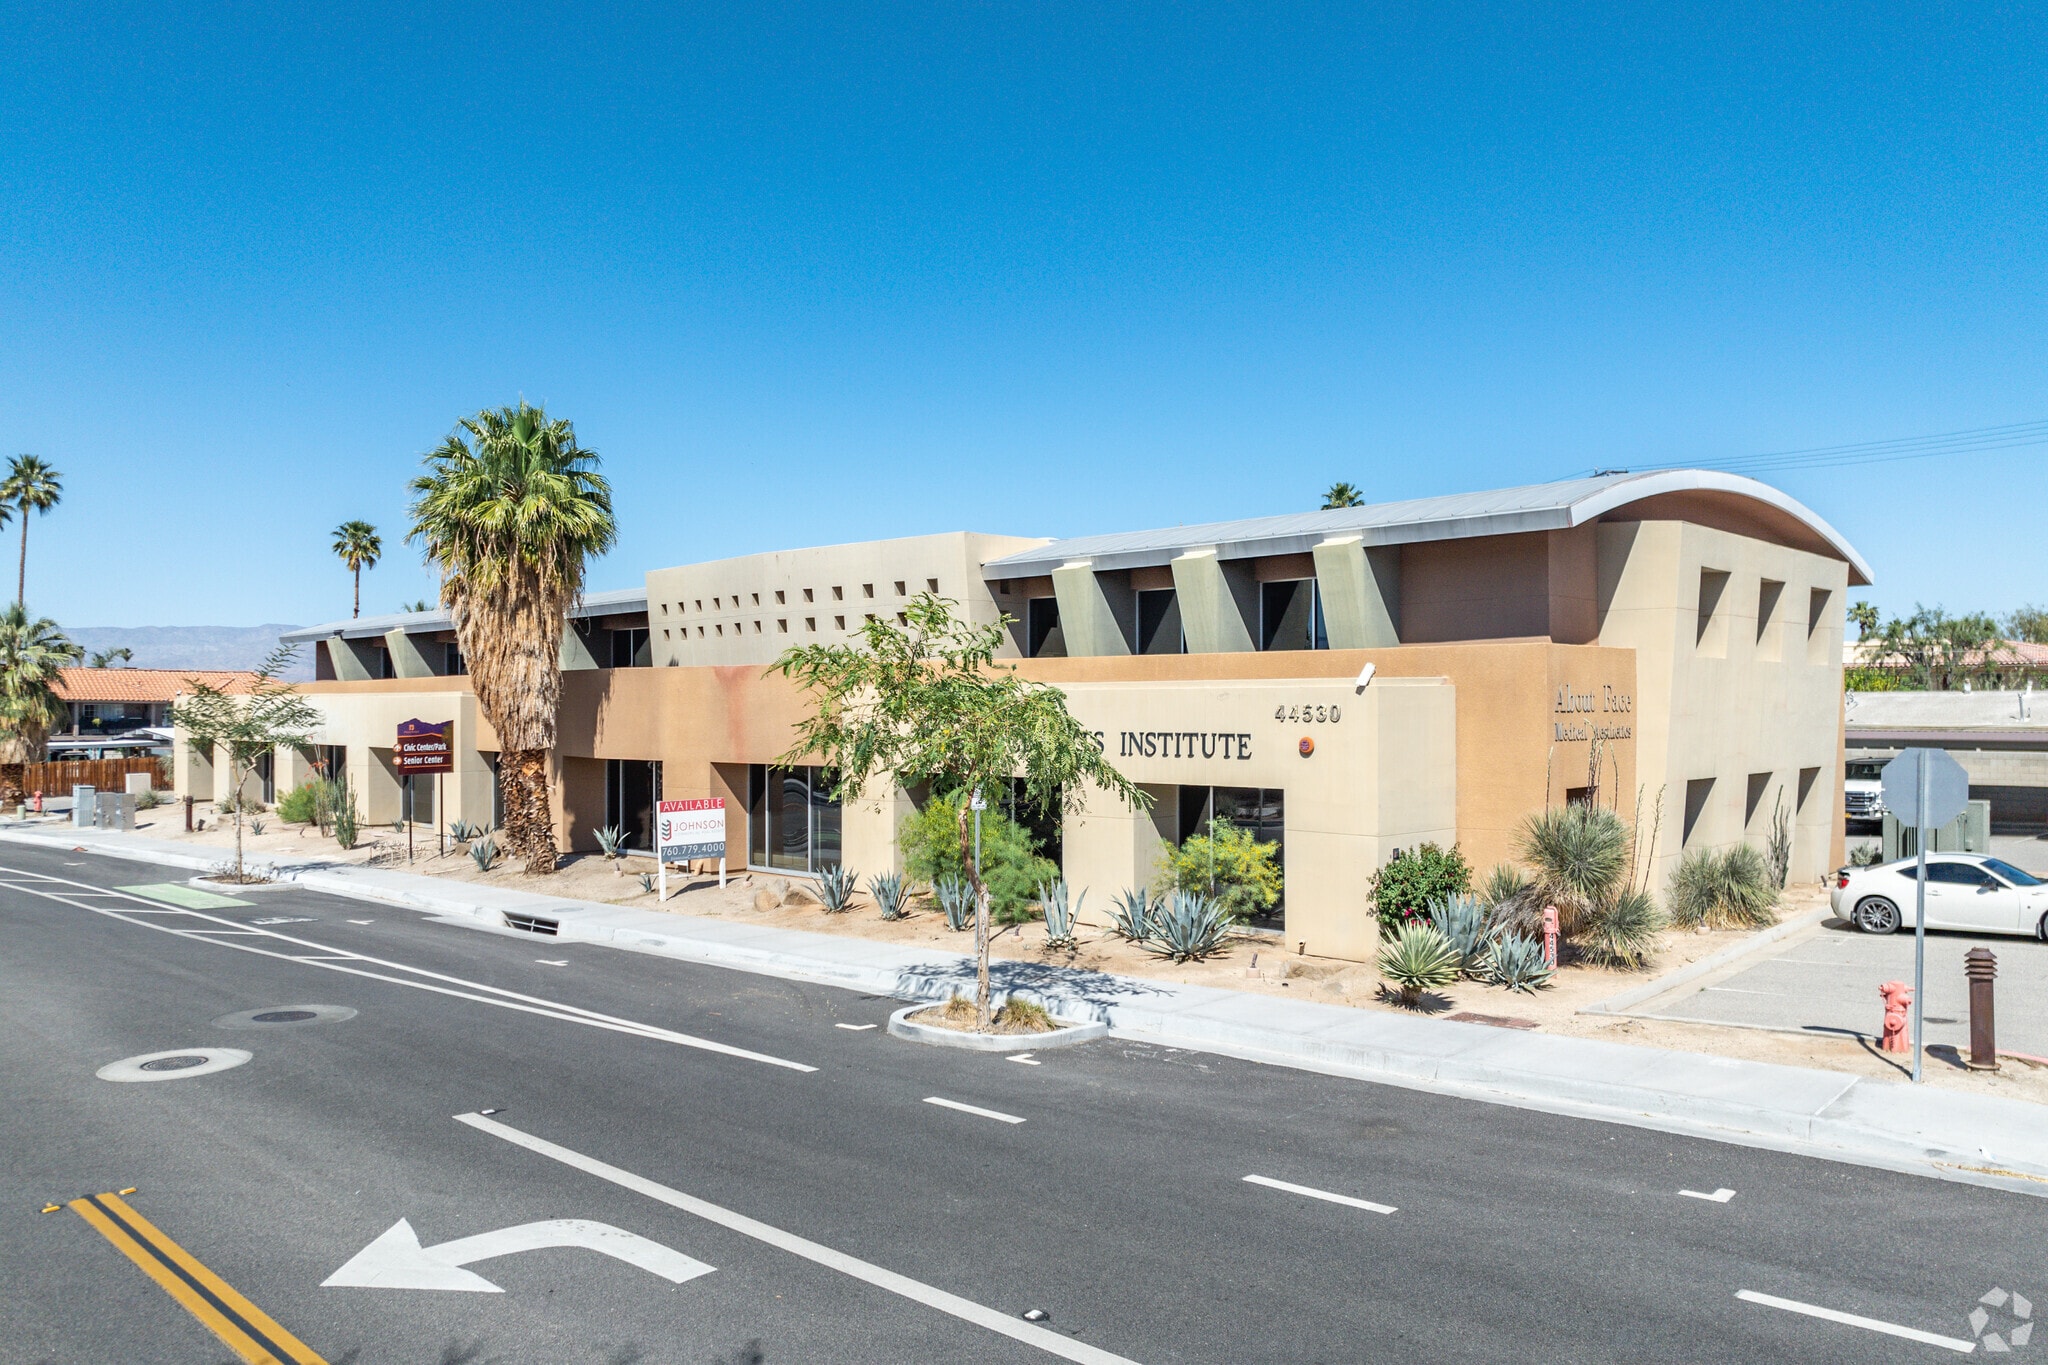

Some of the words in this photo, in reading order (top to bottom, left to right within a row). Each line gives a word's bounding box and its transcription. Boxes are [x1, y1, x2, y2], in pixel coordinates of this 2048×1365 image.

[1554, 683, 1596, 713] About
[1603, 684, 1632, 713] Face
[1274, 703, 1342, 723] 44530
[403, 743, 416, 752] Civic
[417, 742, 447, 752] Center/Park
[1120, 731, 1253, 760] INSTITUTE
[403, 756, 423, 765] Senior
[424, 756, 444, 764] Center
[663, 798, 723, 812] AVAILABLE
[674, 819, 724, 832] JOHNSON
[662, 842, 725, 857] 760.779.4000
